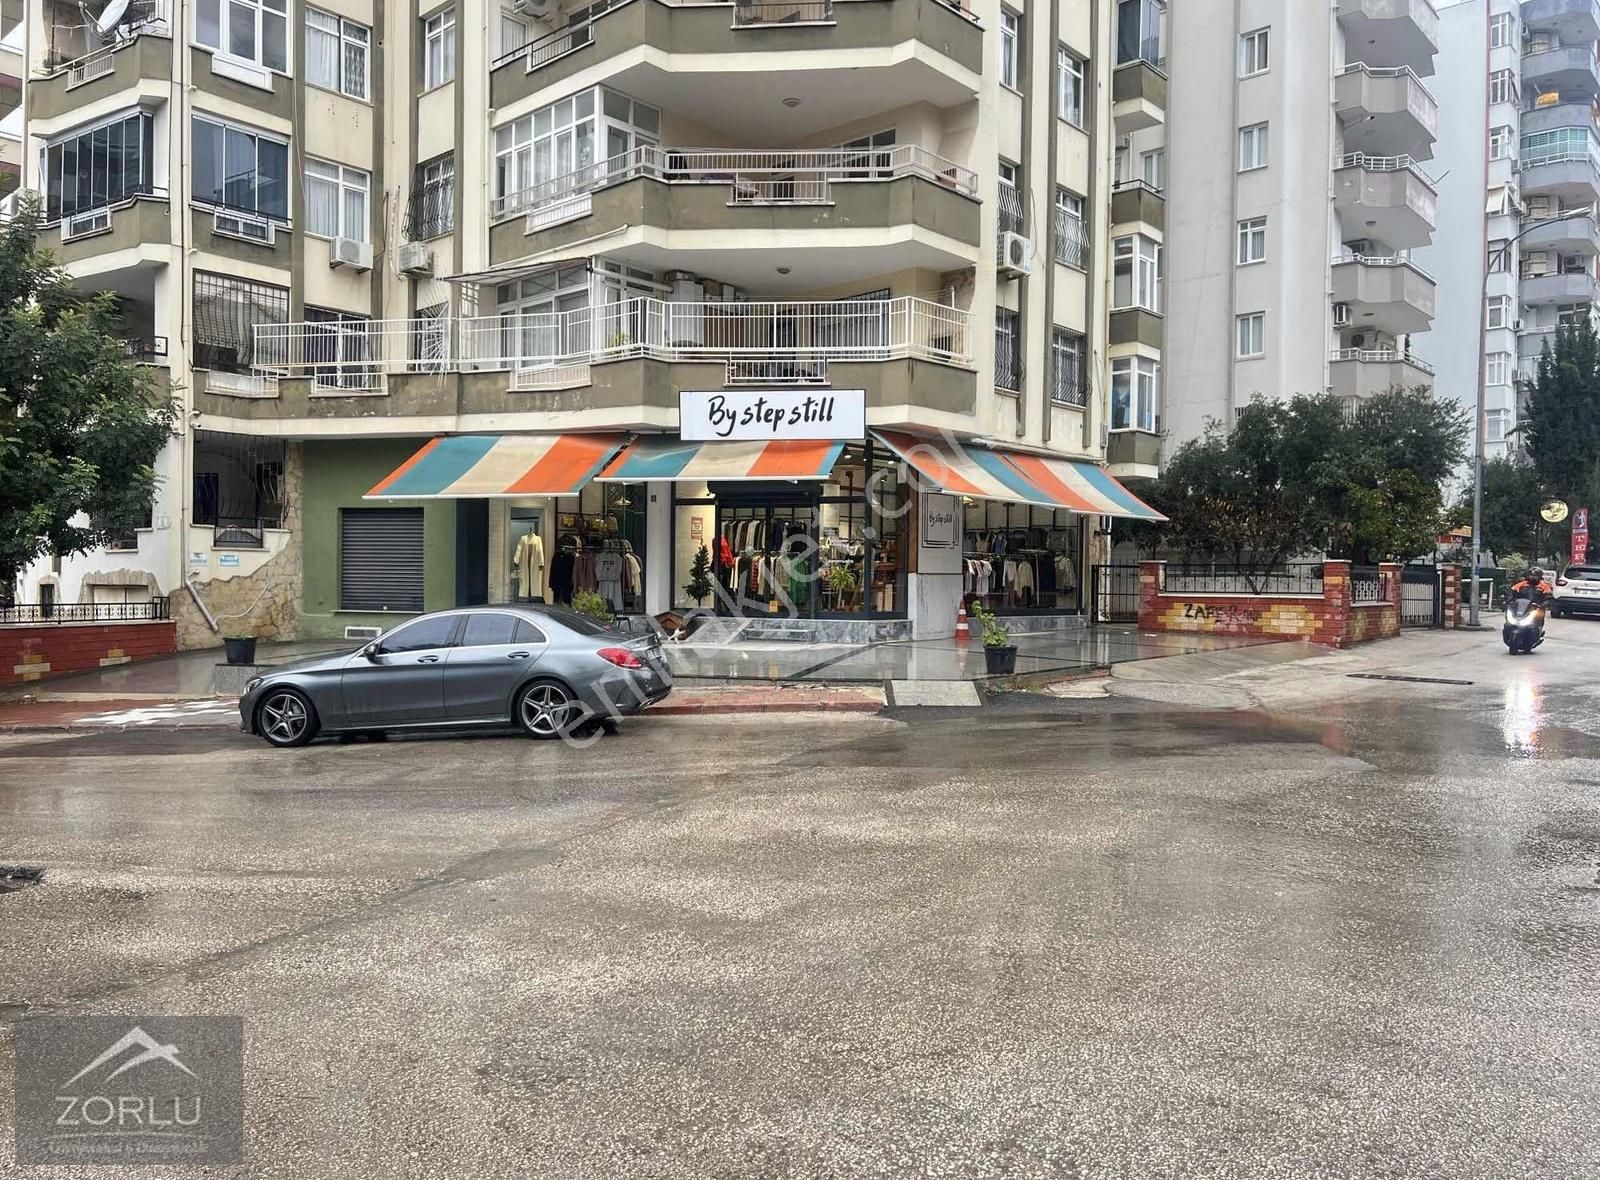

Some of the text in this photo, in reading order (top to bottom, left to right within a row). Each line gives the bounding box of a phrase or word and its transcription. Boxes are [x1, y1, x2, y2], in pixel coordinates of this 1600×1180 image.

[708, 395, 835, 437] By step still
